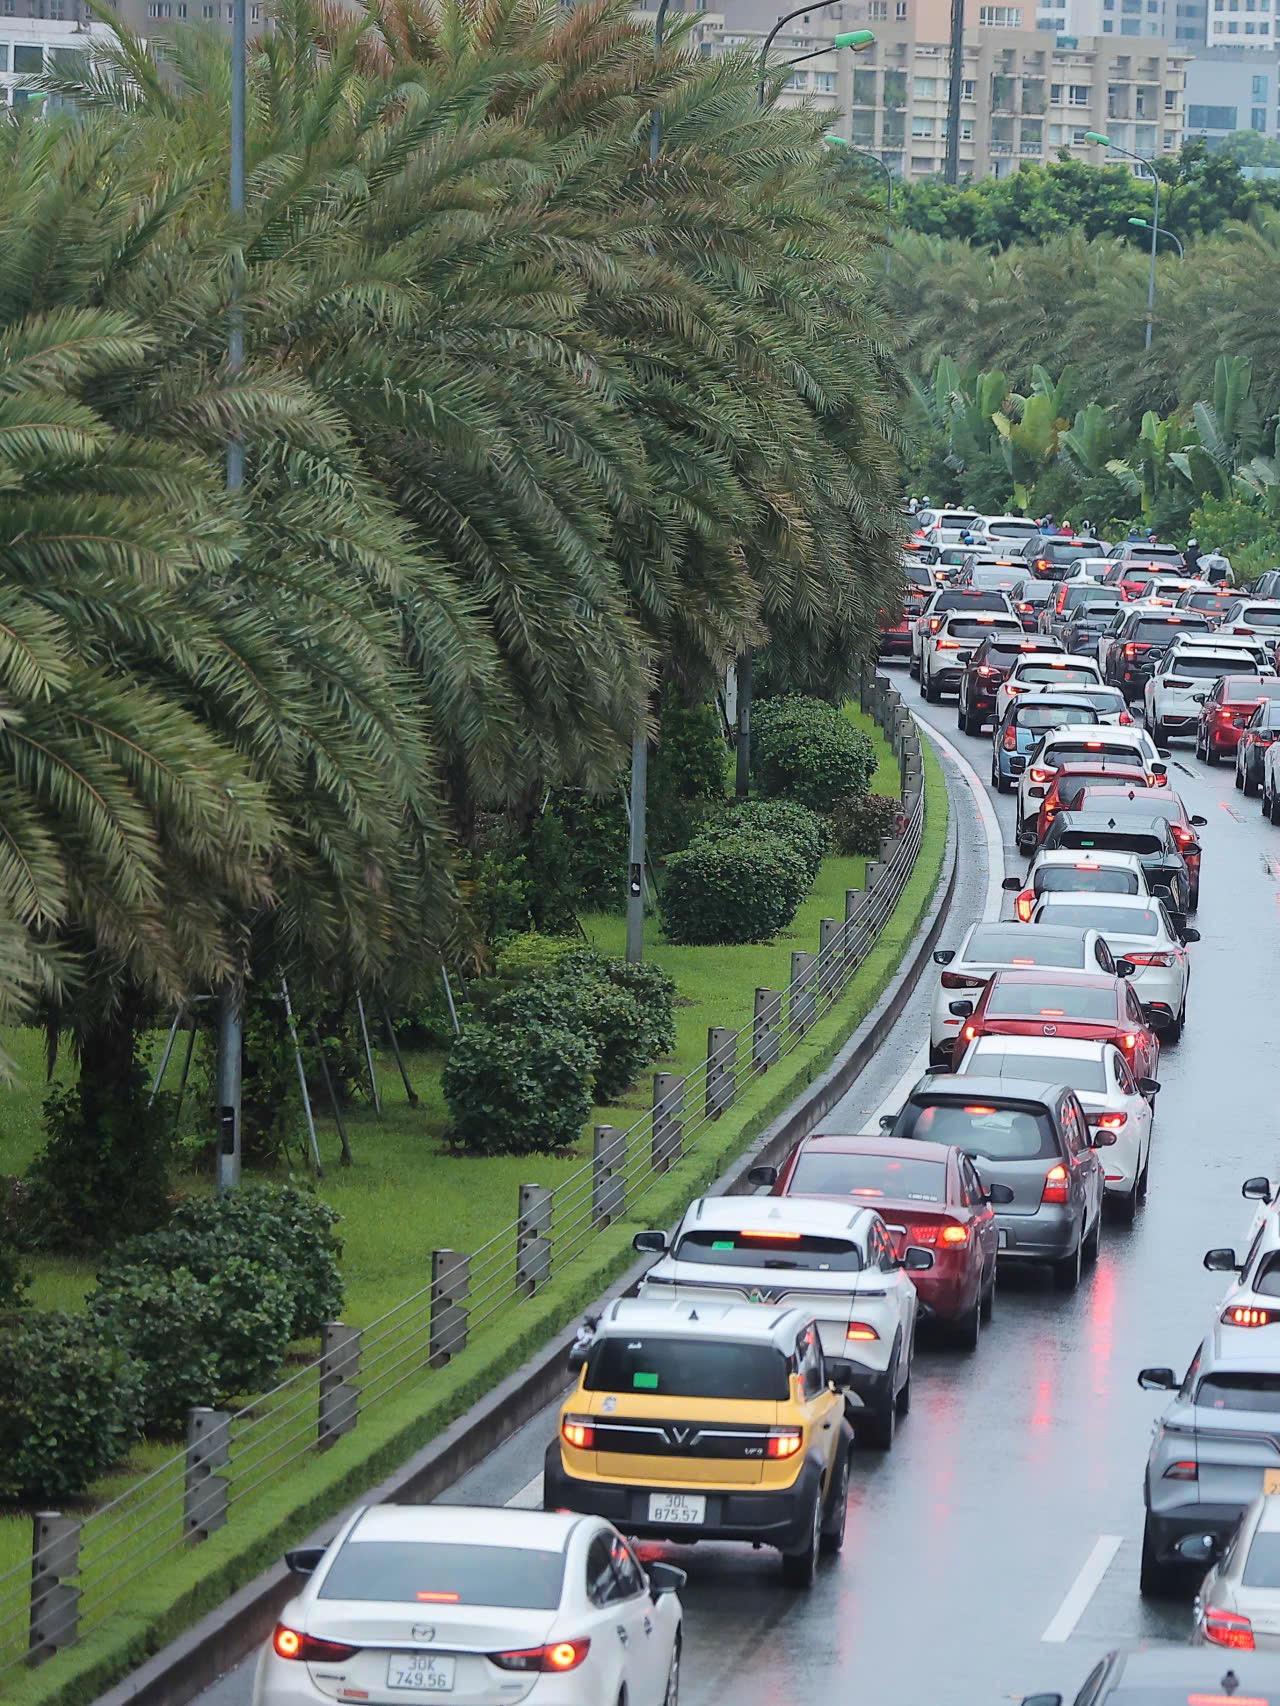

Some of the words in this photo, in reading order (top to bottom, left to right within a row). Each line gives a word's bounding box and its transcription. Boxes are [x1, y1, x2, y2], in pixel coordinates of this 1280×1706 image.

[664, 1495, 689, 1508] 30L
[655, 1508, 698, 1521] 875.57
[408, 1655, 435, 1671] 30K
[396, 1672, 446, 1688] 749.56
